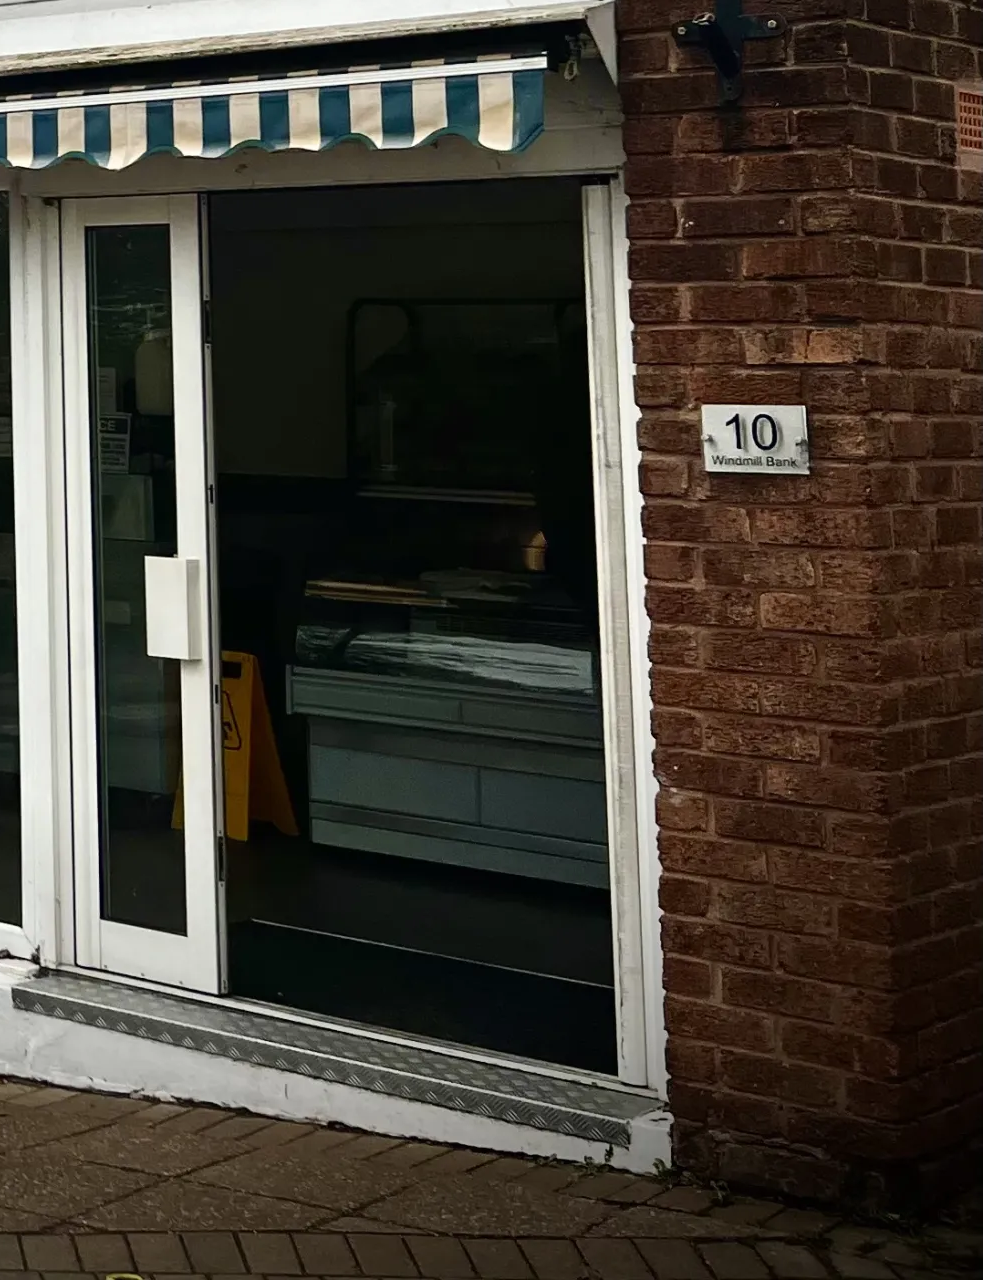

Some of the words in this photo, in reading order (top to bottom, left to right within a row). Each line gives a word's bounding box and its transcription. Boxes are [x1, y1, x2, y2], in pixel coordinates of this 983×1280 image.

[725, 413, 778, 451] 10
[711, 455, 763, 467] Windmill
[766, 456, 798, 468] Bank
